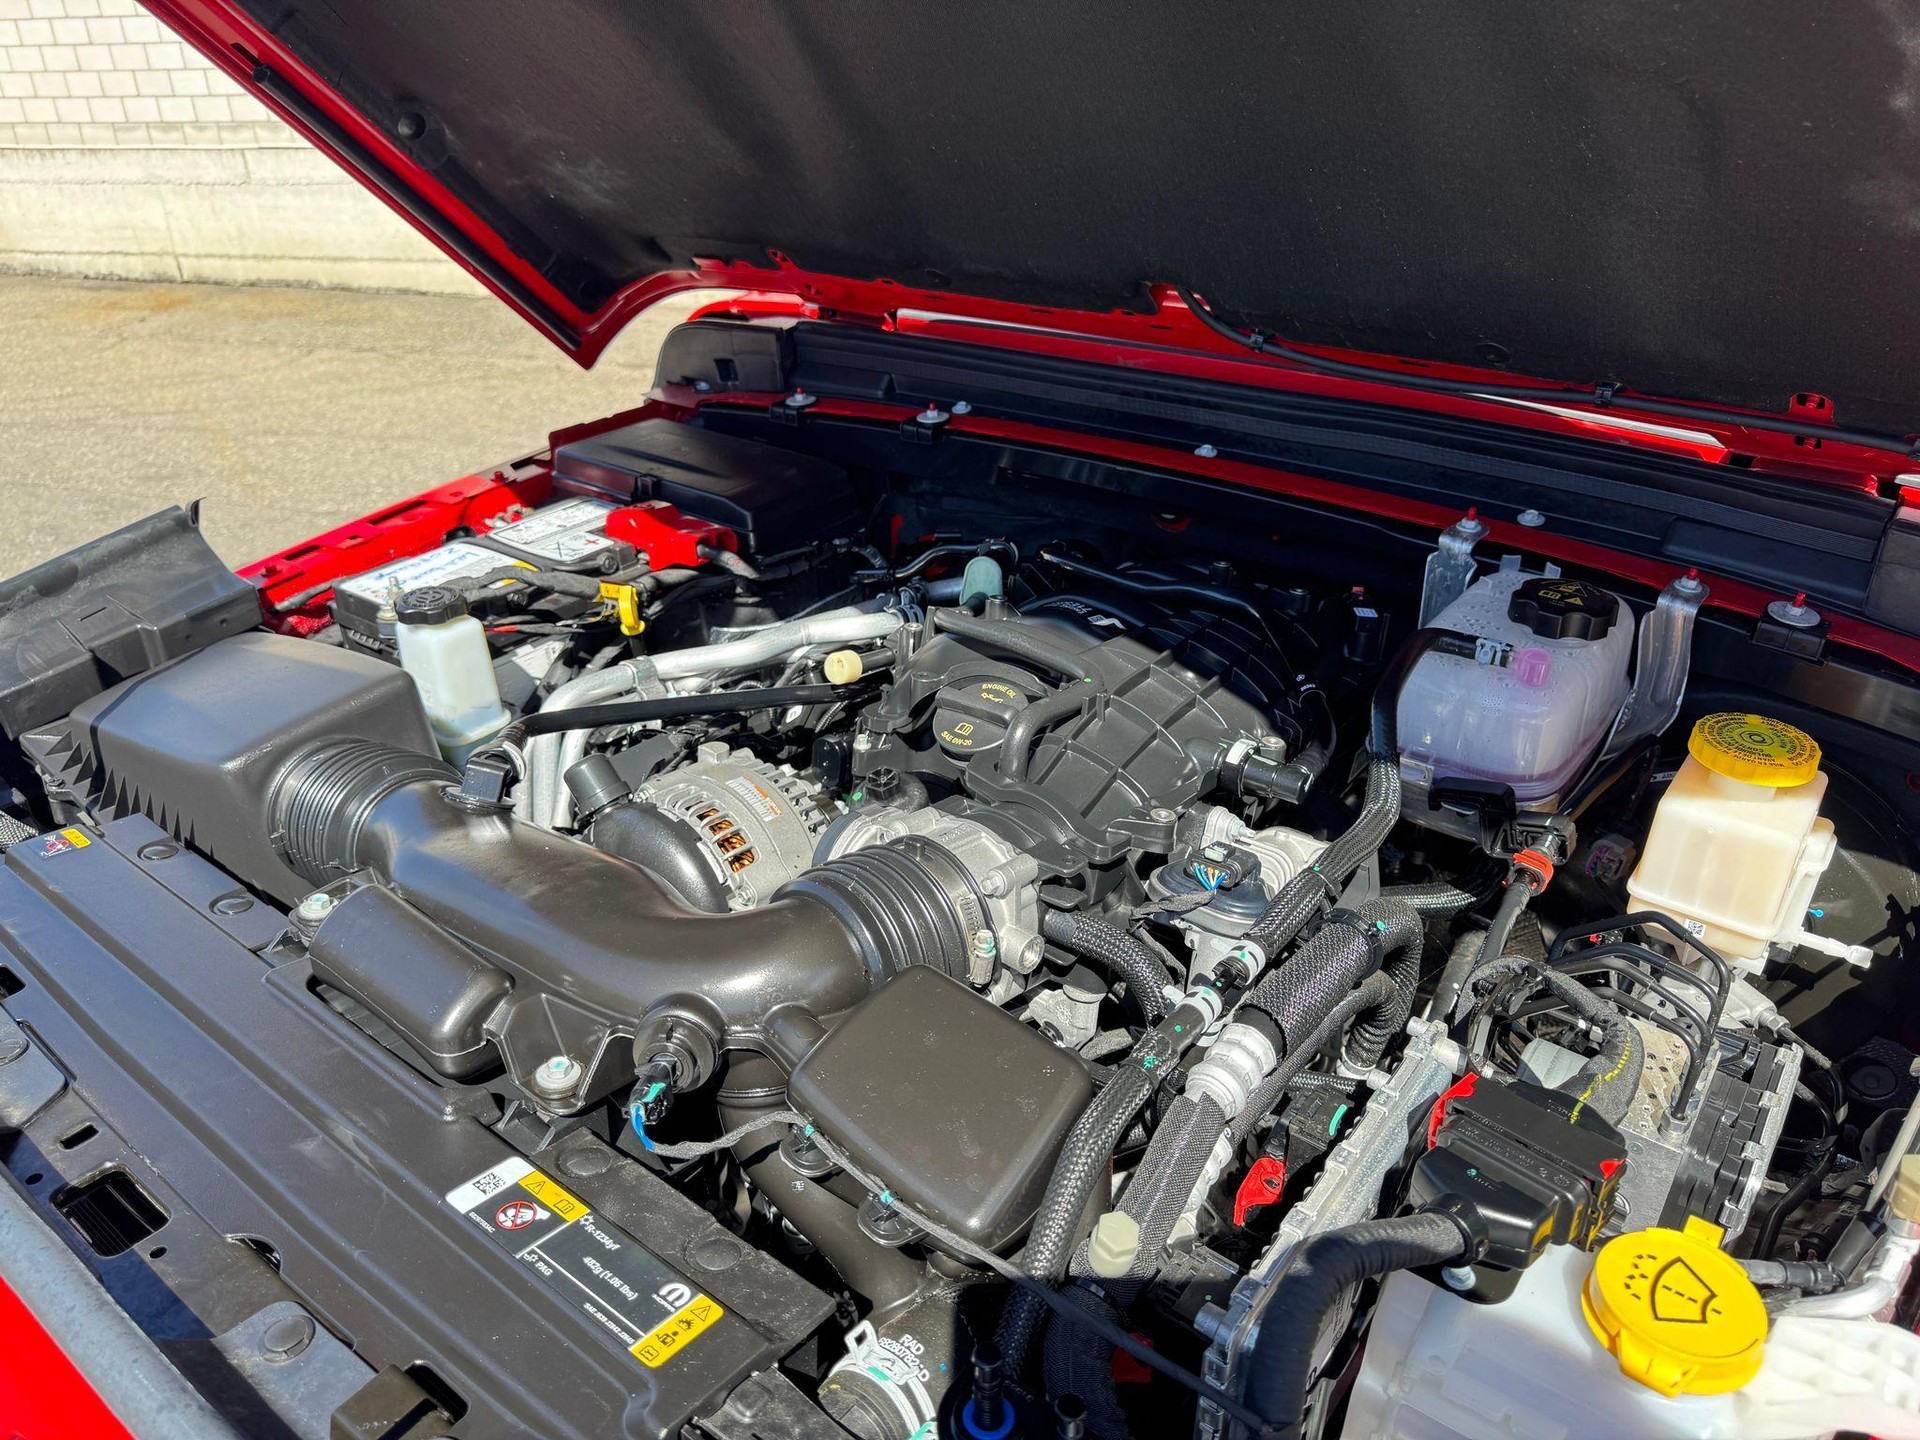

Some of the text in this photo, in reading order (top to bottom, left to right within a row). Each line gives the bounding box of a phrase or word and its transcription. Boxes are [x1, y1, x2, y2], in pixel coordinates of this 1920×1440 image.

[982, 683, 1017, 699] ENGINE OIL
[941, 730, 973, 746] SAE 0W-20
[584, 1224, 621, 1251] R-1234yf
[535, 1261, 554, 1276] PAG
[582, 1256, 639, 1301] 482g (1.06 lbs)
[899, 1333, 925, 1355] RAD
